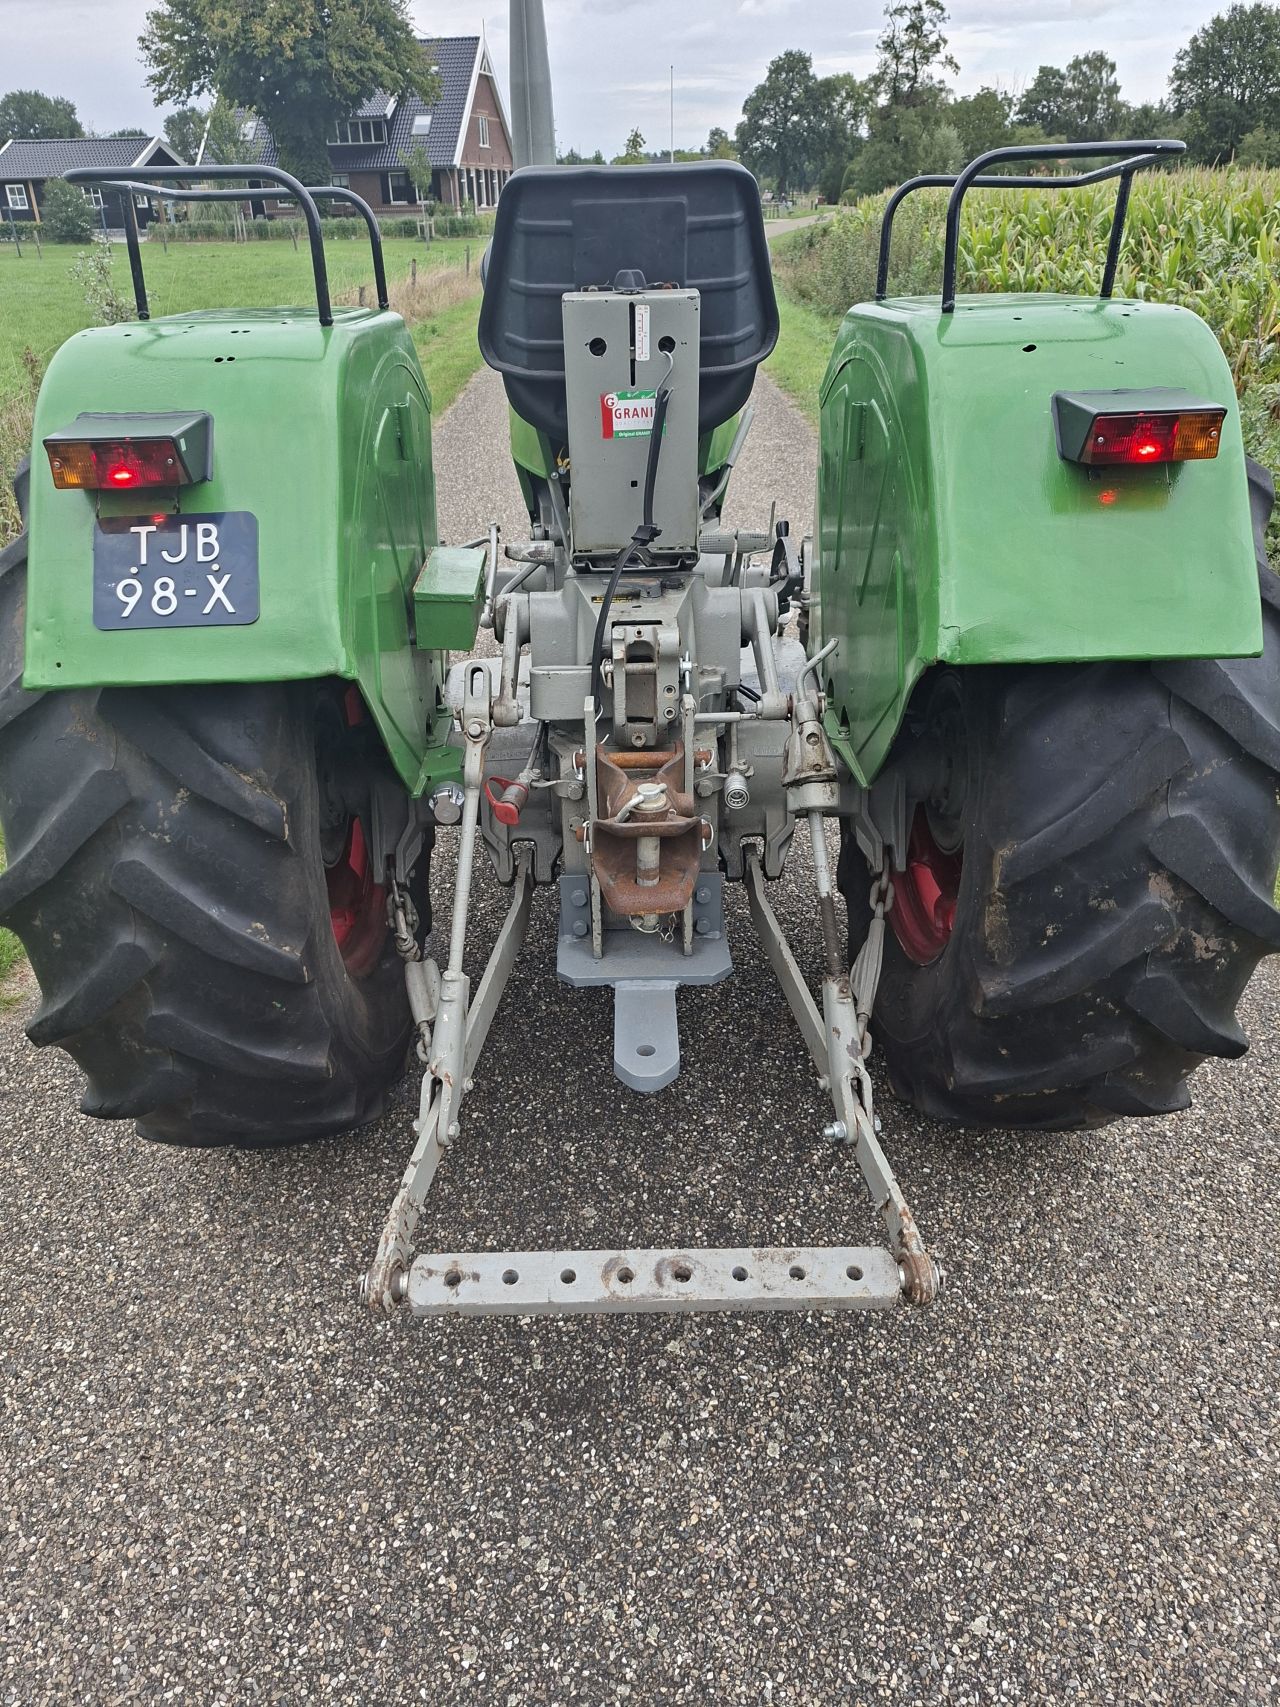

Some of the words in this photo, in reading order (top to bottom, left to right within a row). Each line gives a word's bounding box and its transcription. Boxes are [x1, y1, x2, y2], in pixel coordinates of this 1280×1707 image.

[605, 397, 615, 407] G
[614, 406, 653, 420] GRANI
[130, 523, 220, 565] TJB
[116, 573, 236, 618] 98-X
